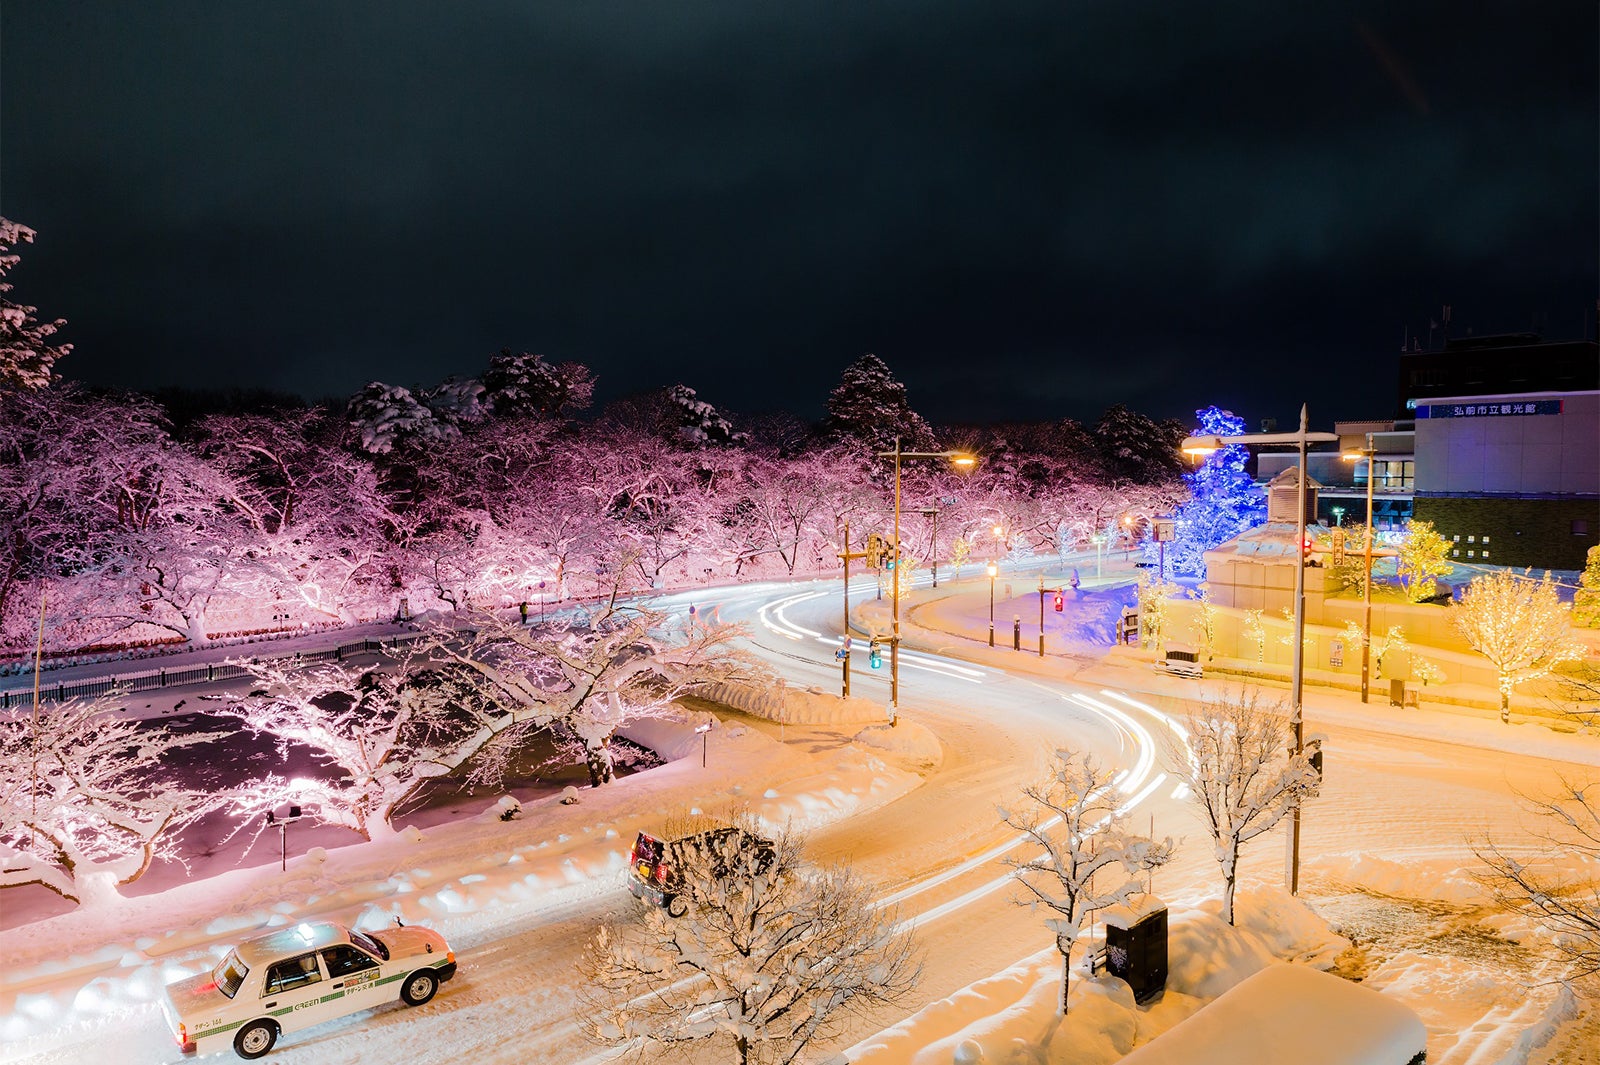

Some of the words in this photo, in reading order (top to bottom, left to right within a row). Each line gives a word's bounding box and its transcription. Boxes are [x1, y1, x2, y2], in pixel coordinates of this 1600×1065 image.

[1454, 404, 1536, 416] 弘前市立観光館
[294, 998, 319, 1011] GREEN
